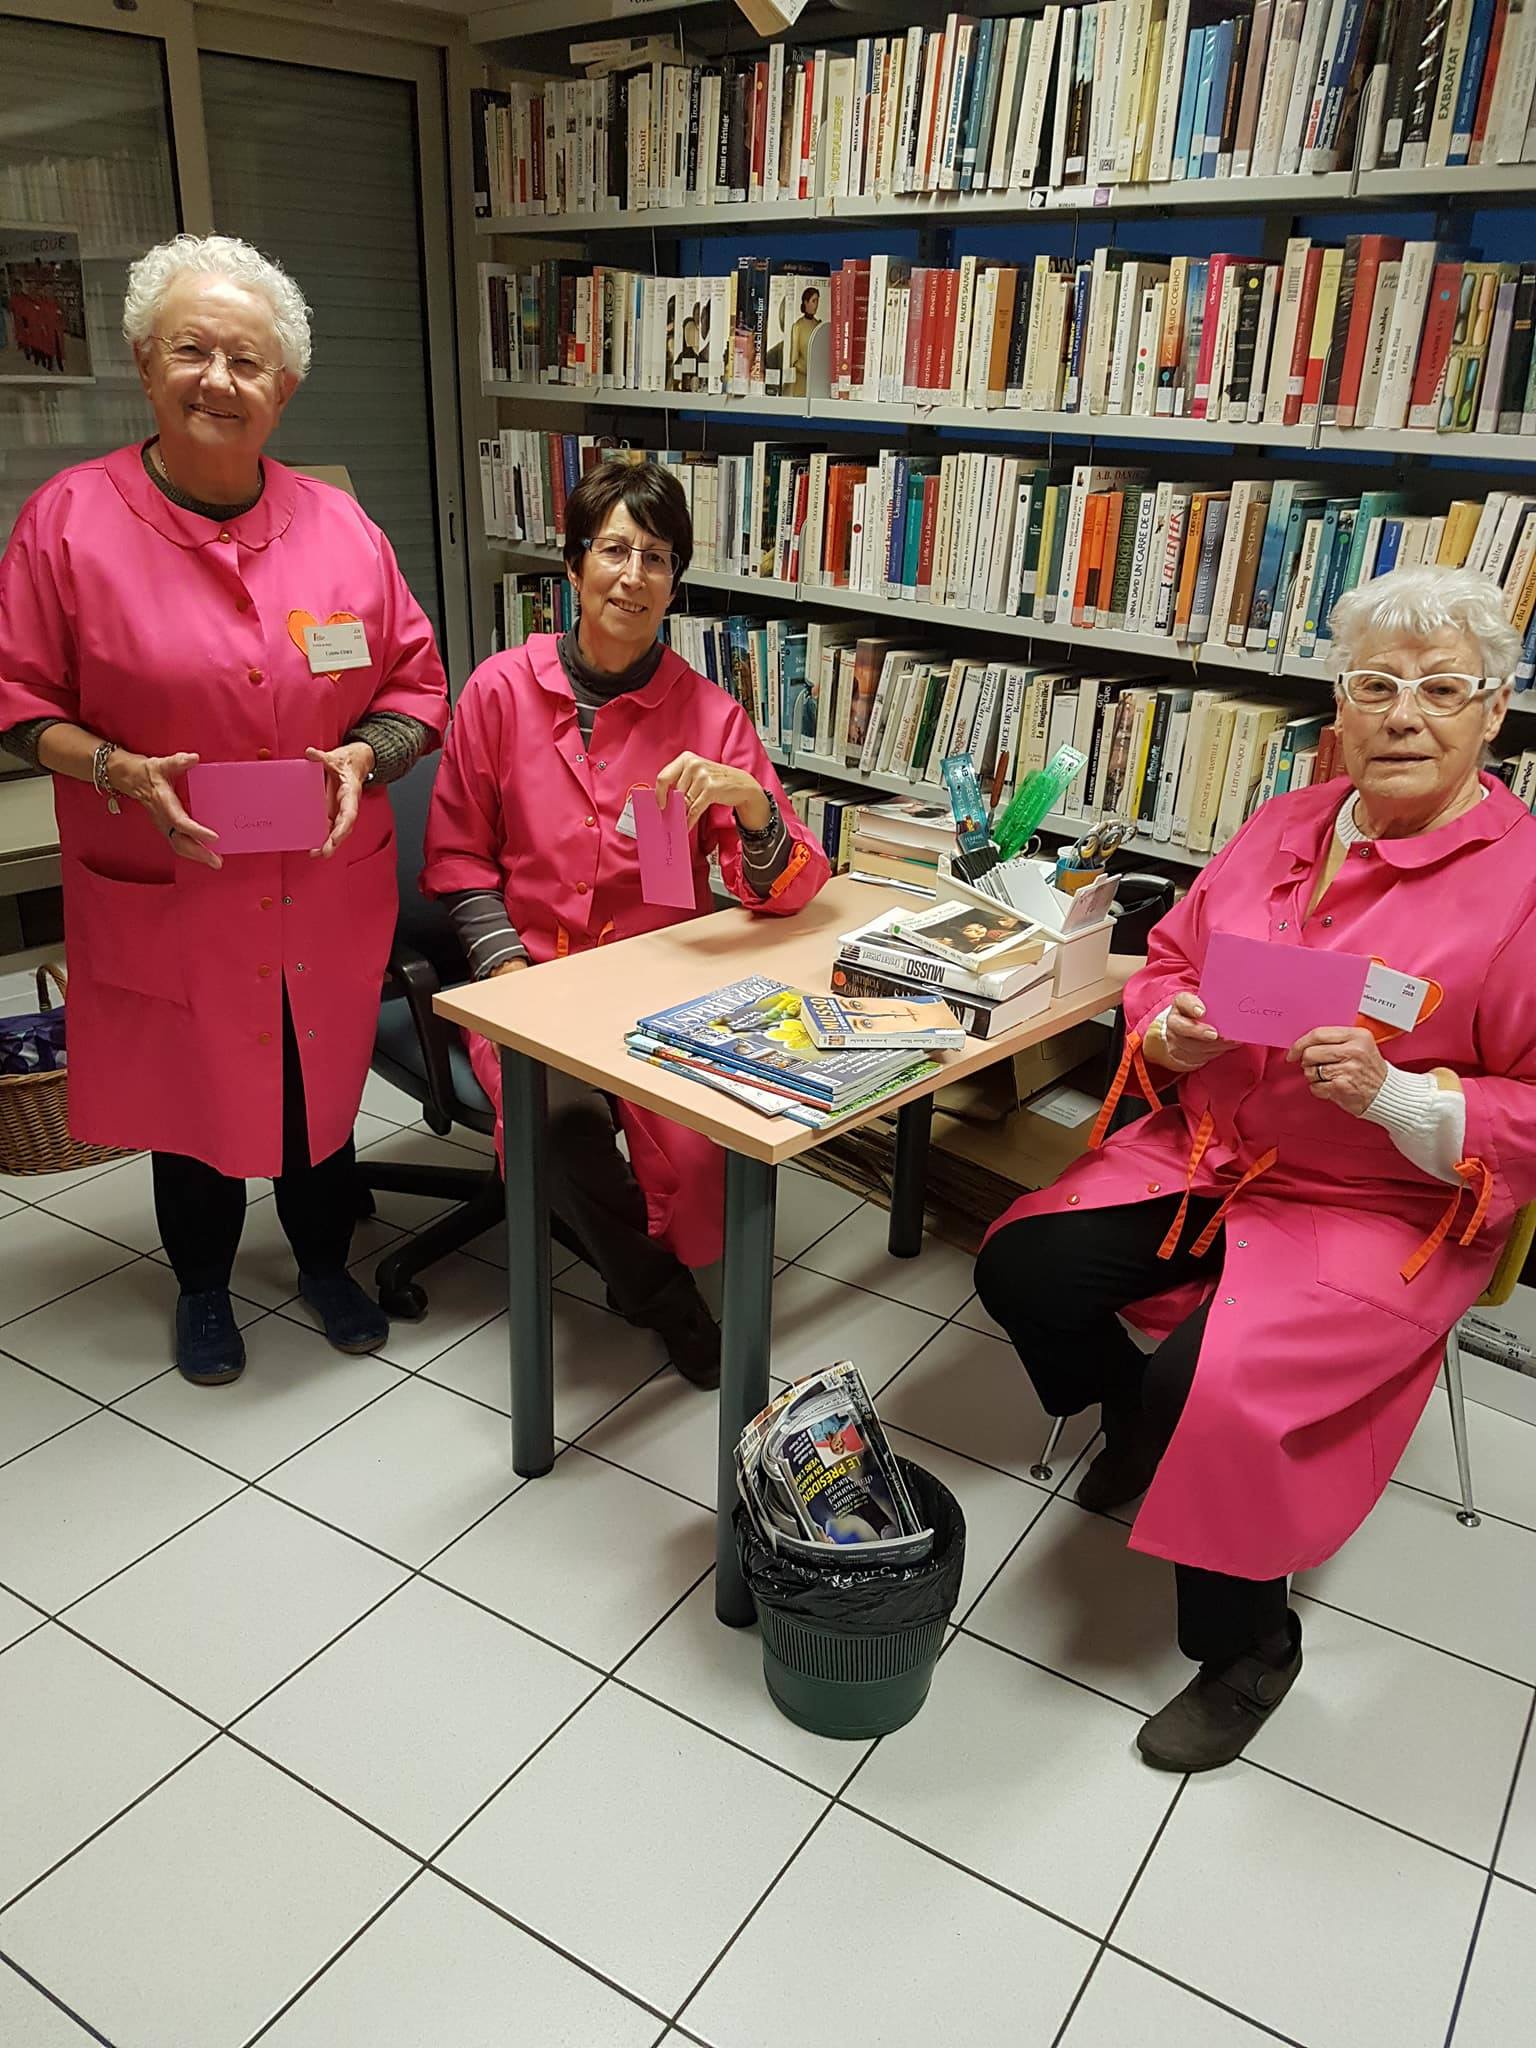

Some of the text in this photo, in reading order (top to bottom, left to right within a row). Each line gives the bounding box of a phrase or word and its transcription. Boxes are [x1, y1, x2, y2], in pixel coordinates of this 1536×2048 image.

[906, 959, 946, 983] MUSSO
[660, 985, 742, 1032] ESPRIT
[1378, 998, 1397, 1009] PETIT
[805, 1457, 820, 1473] VERS
[812, 1466, 825, 1477] EN
[802, 1457, 862, 1504] LE PRÉSIDEN
[833, 1486, 870, 1511] Investiture
